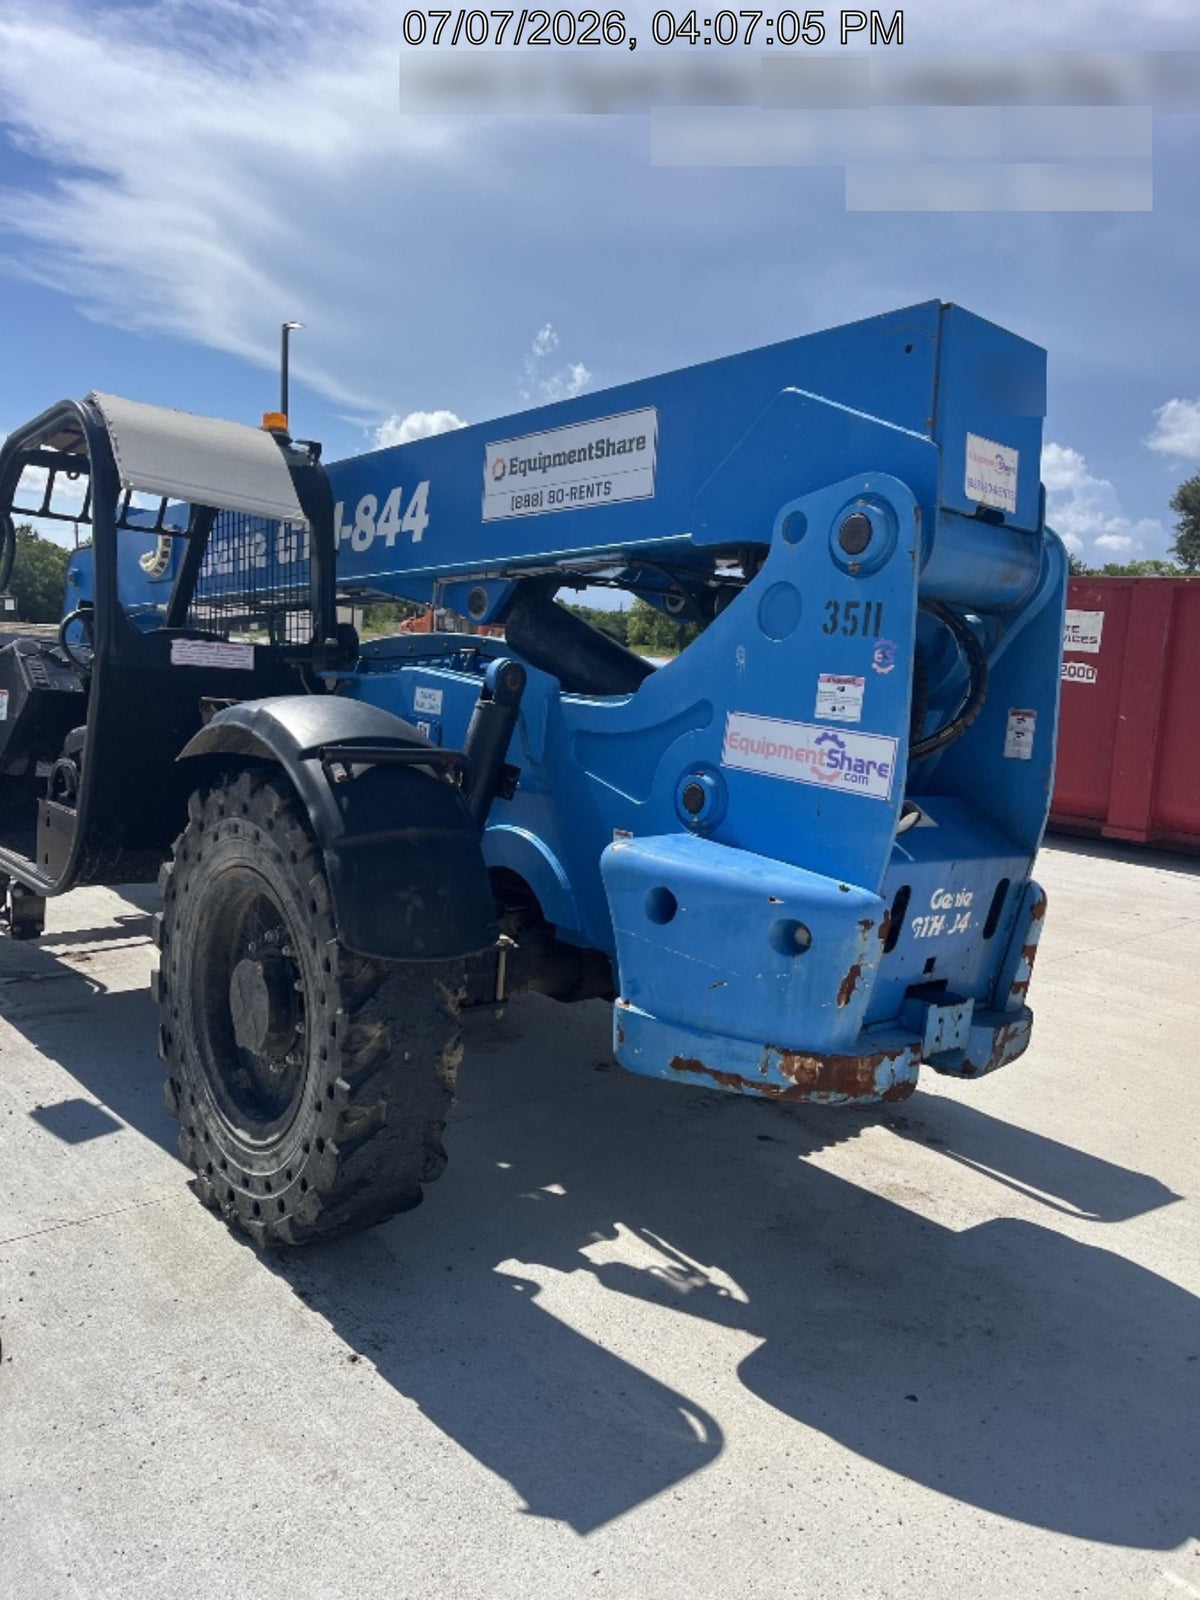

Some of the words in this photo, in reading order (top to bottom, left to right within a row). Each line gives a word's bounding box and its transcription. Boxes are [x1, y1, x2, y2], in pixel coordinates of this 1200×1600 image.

[508, 435, 647, 477] EquipmentShare
[547, 481, 612, 505] 80-RENTS
[822, 600, 883, 638] 3511
[726, 731, 890, 780] EquipmentShare
